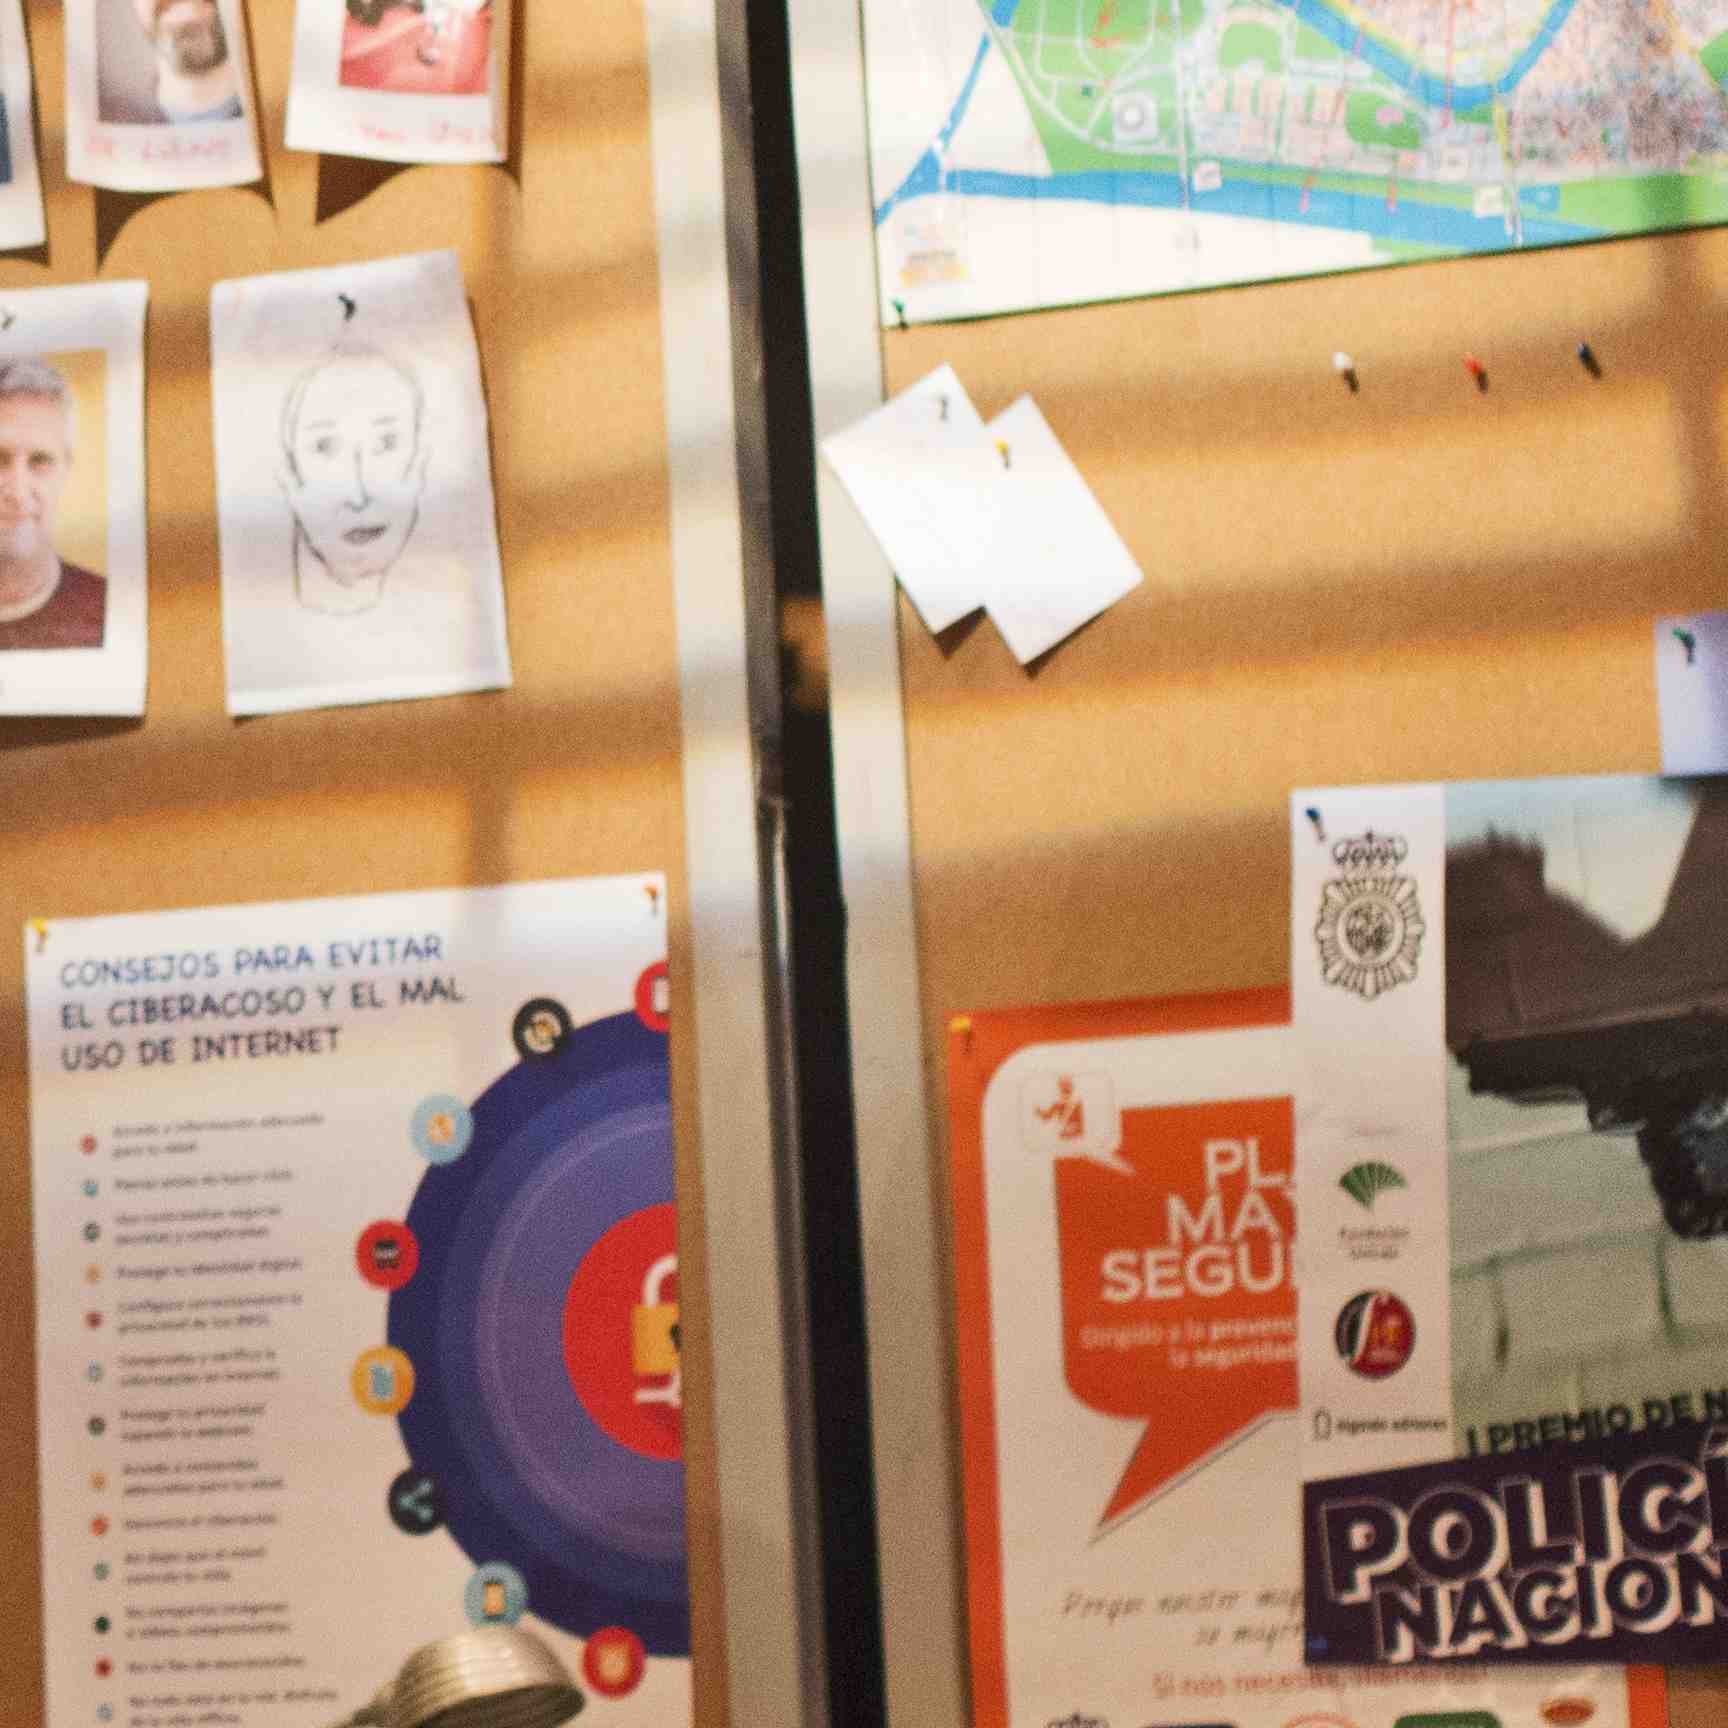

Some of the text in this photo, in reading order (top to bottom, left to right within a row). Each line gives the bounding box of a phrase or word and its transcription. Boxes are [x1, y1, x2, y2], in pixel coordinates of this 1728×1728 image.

[60, 934, 444, 989] CONSEJOS PARA EVITAR
[60, 975, 465, 1030] EL CIBERACOSO Y EL MAL
[61, 1024, 343, 1072] USO DE INTERNET
[1204, 1136, 1296, 1198] PL
[1165, 1187, 1297, 1245] MA
[1100, 1239, 1298, 1304] SEGU
[1488, 1404, 1633, 1454] PREMIO
